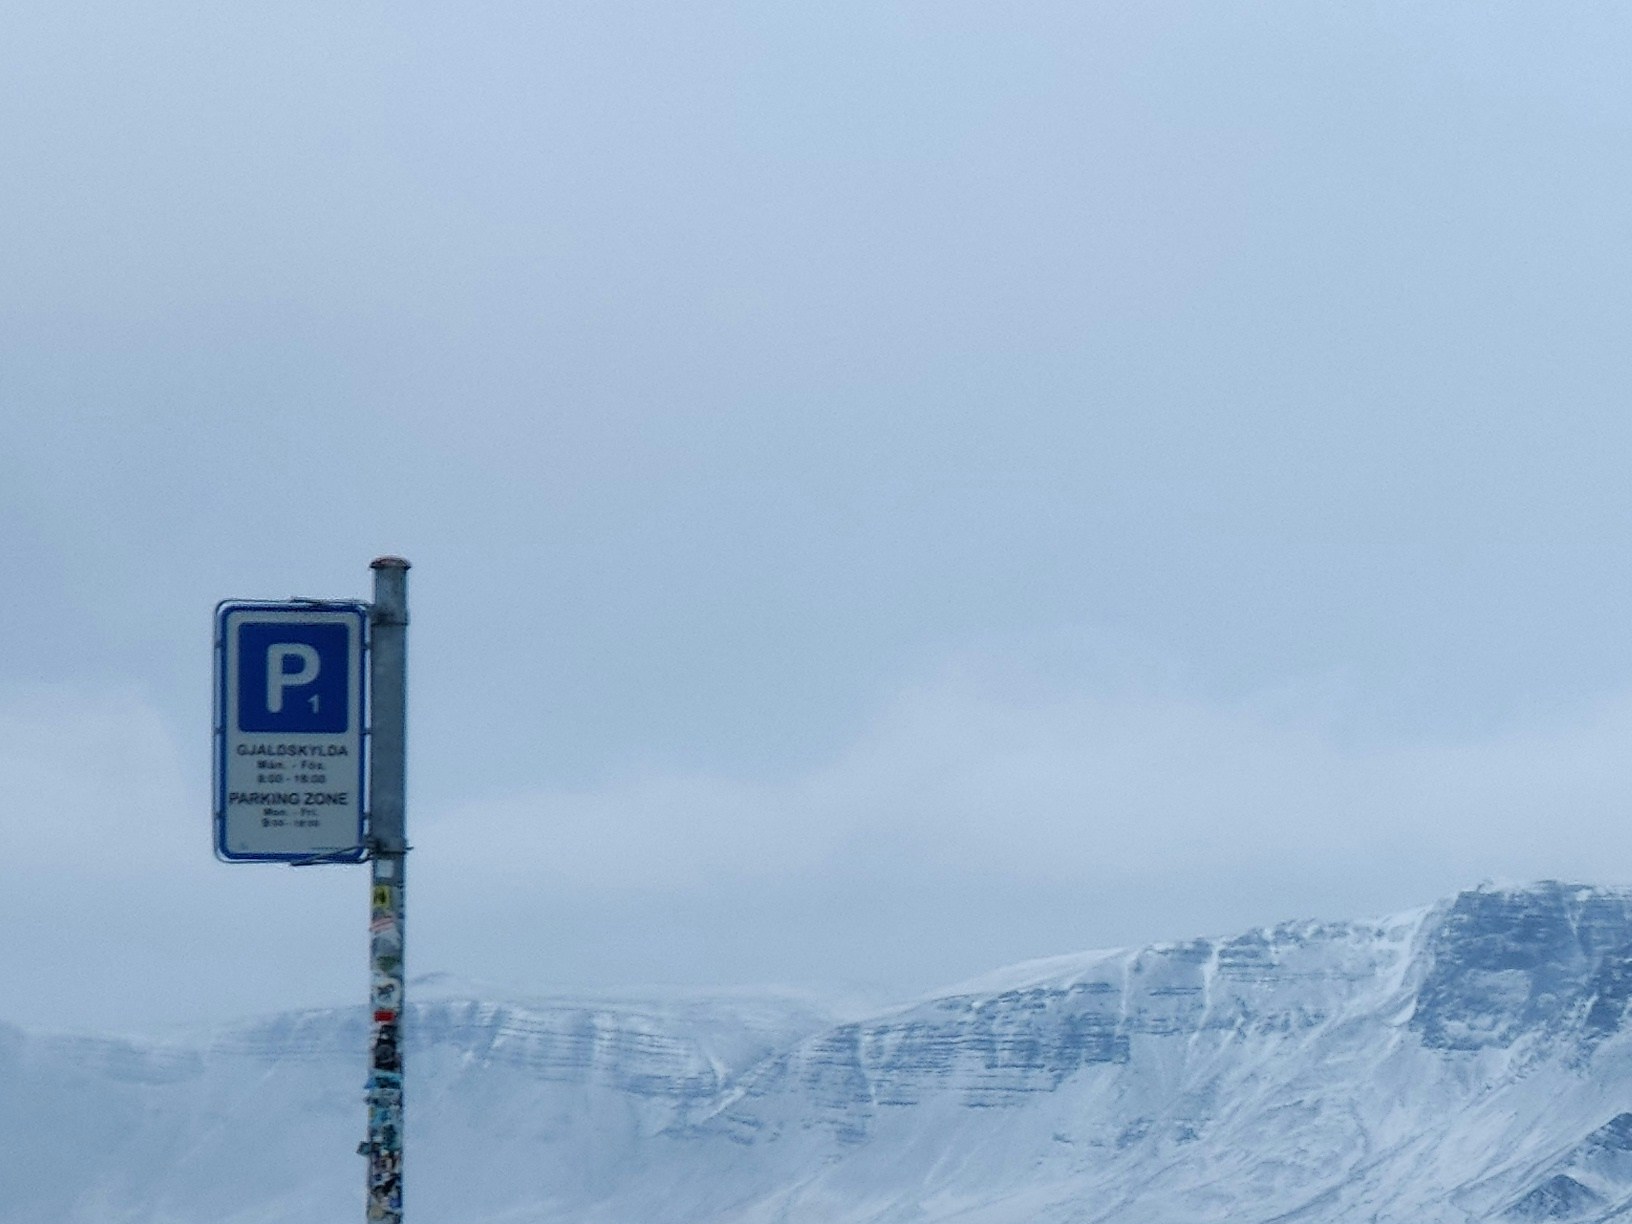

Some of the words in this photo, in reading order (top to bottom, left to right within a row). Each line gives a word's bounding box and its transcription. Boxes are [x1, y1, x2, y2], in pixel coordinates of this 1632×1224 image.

[267, 643, 321, 714] P
[307, 694, 320, 714] 1
[236, 744, 348, 756] GJALDSKYLDA
[229, 792, 300, 805] PARKING
[304, 792, 349, 806] ZONE
